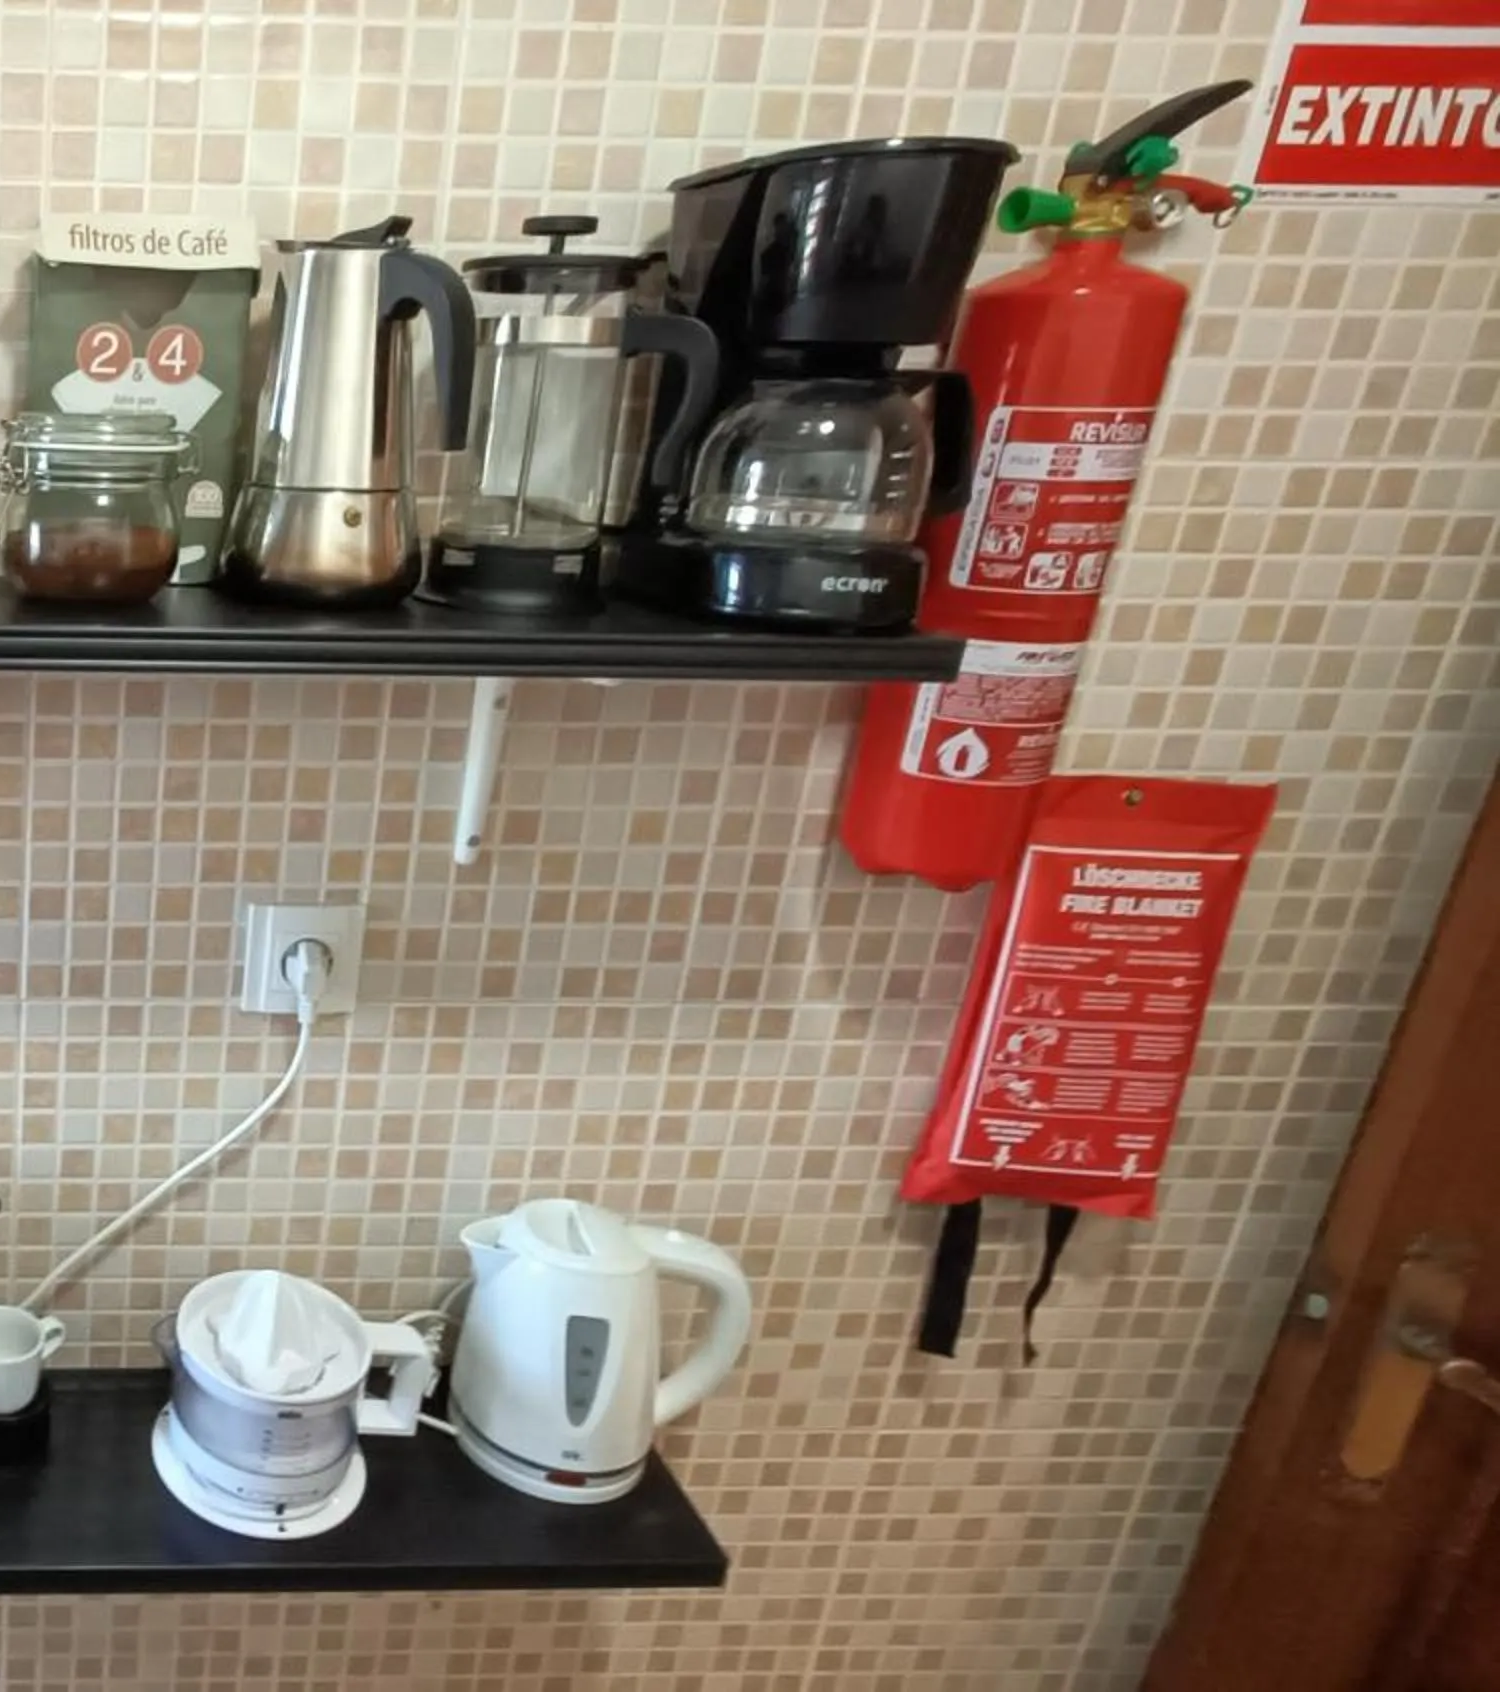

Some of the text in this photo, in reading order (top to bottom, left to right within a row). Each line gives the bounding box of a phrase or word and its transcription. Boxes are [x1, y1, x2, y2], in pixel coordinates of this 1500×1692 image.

[68, 223, 228, 256] filtros de Café
[90, 331, 118, 374] 2
[158, 333, 187, 376] 4
